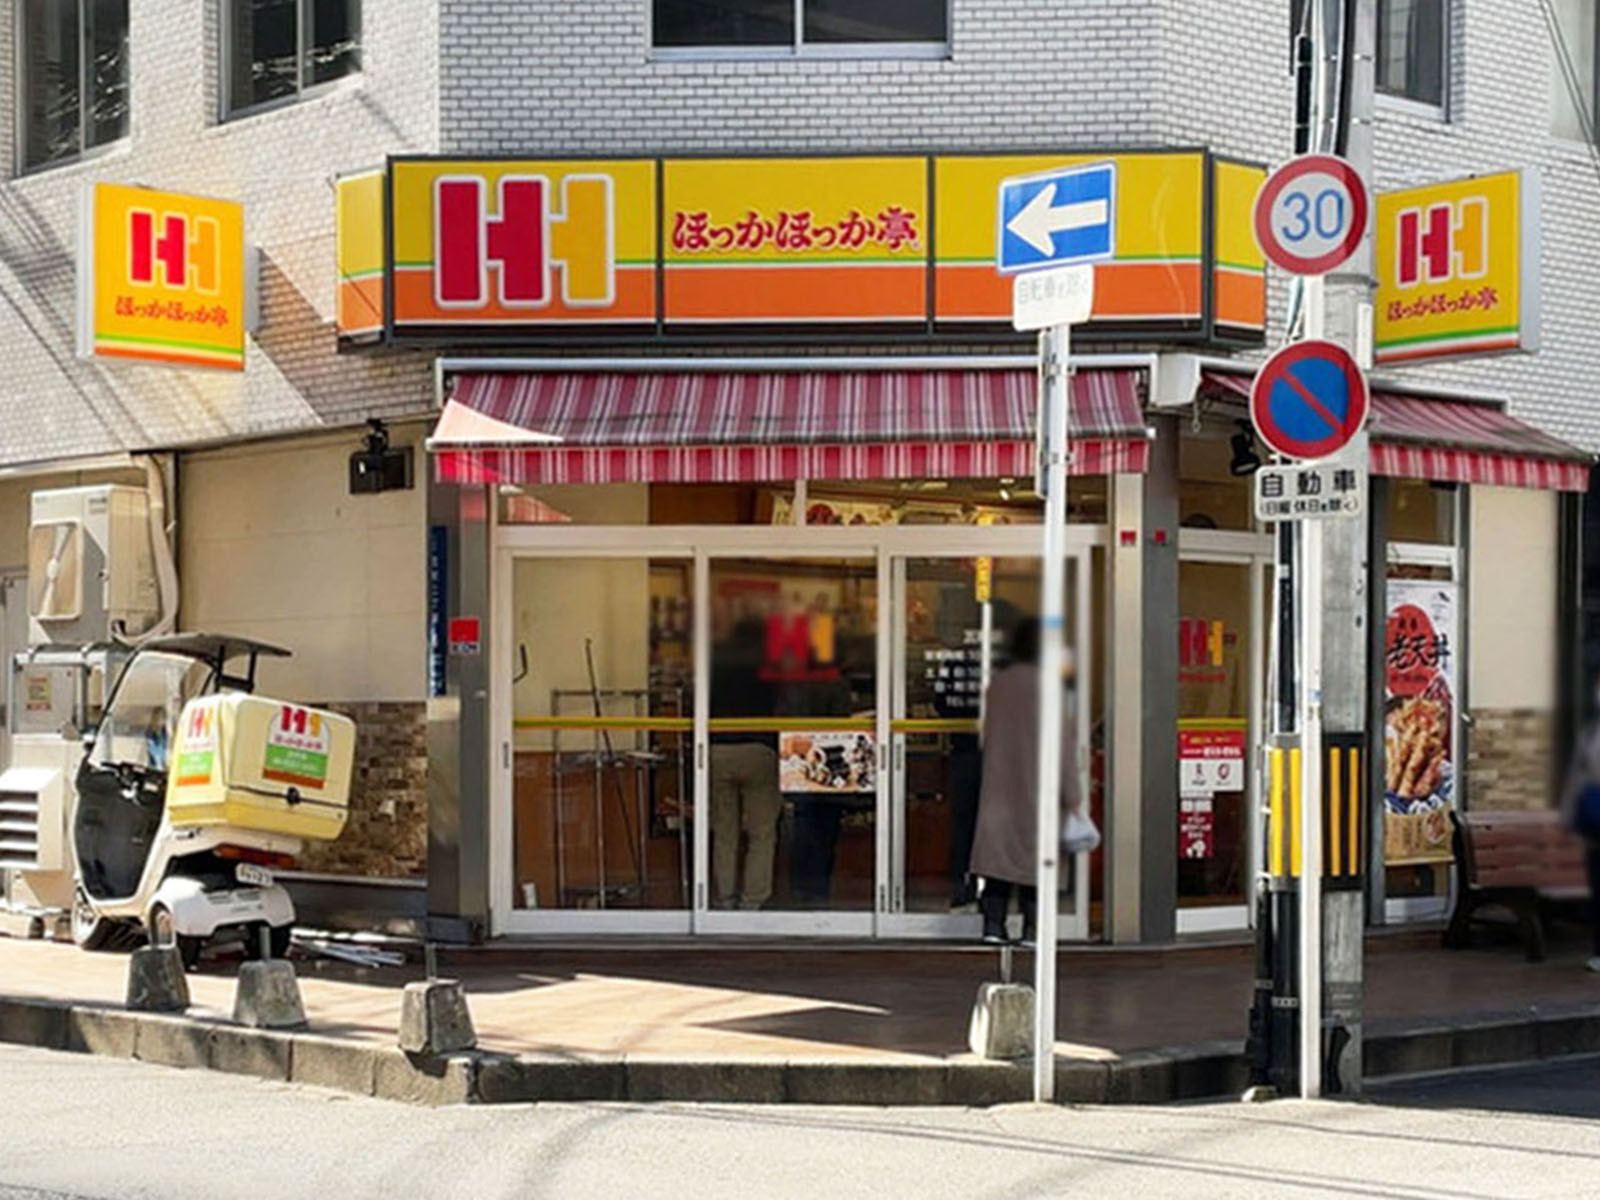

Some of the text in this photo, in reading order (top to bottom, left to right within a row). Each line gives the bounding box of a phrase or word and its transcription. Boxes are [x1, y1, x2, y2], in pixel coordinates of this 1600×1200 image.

[671, 206, 920, 252] ほっかほっか亭
[1282, 189, 1344, 242] 30
[115, 295, 229, 328] ほっかほっか亭
[1387, 286, 1499, 322] ほっかほっか亭
[1261, 468, 1357, 498] 自動車
